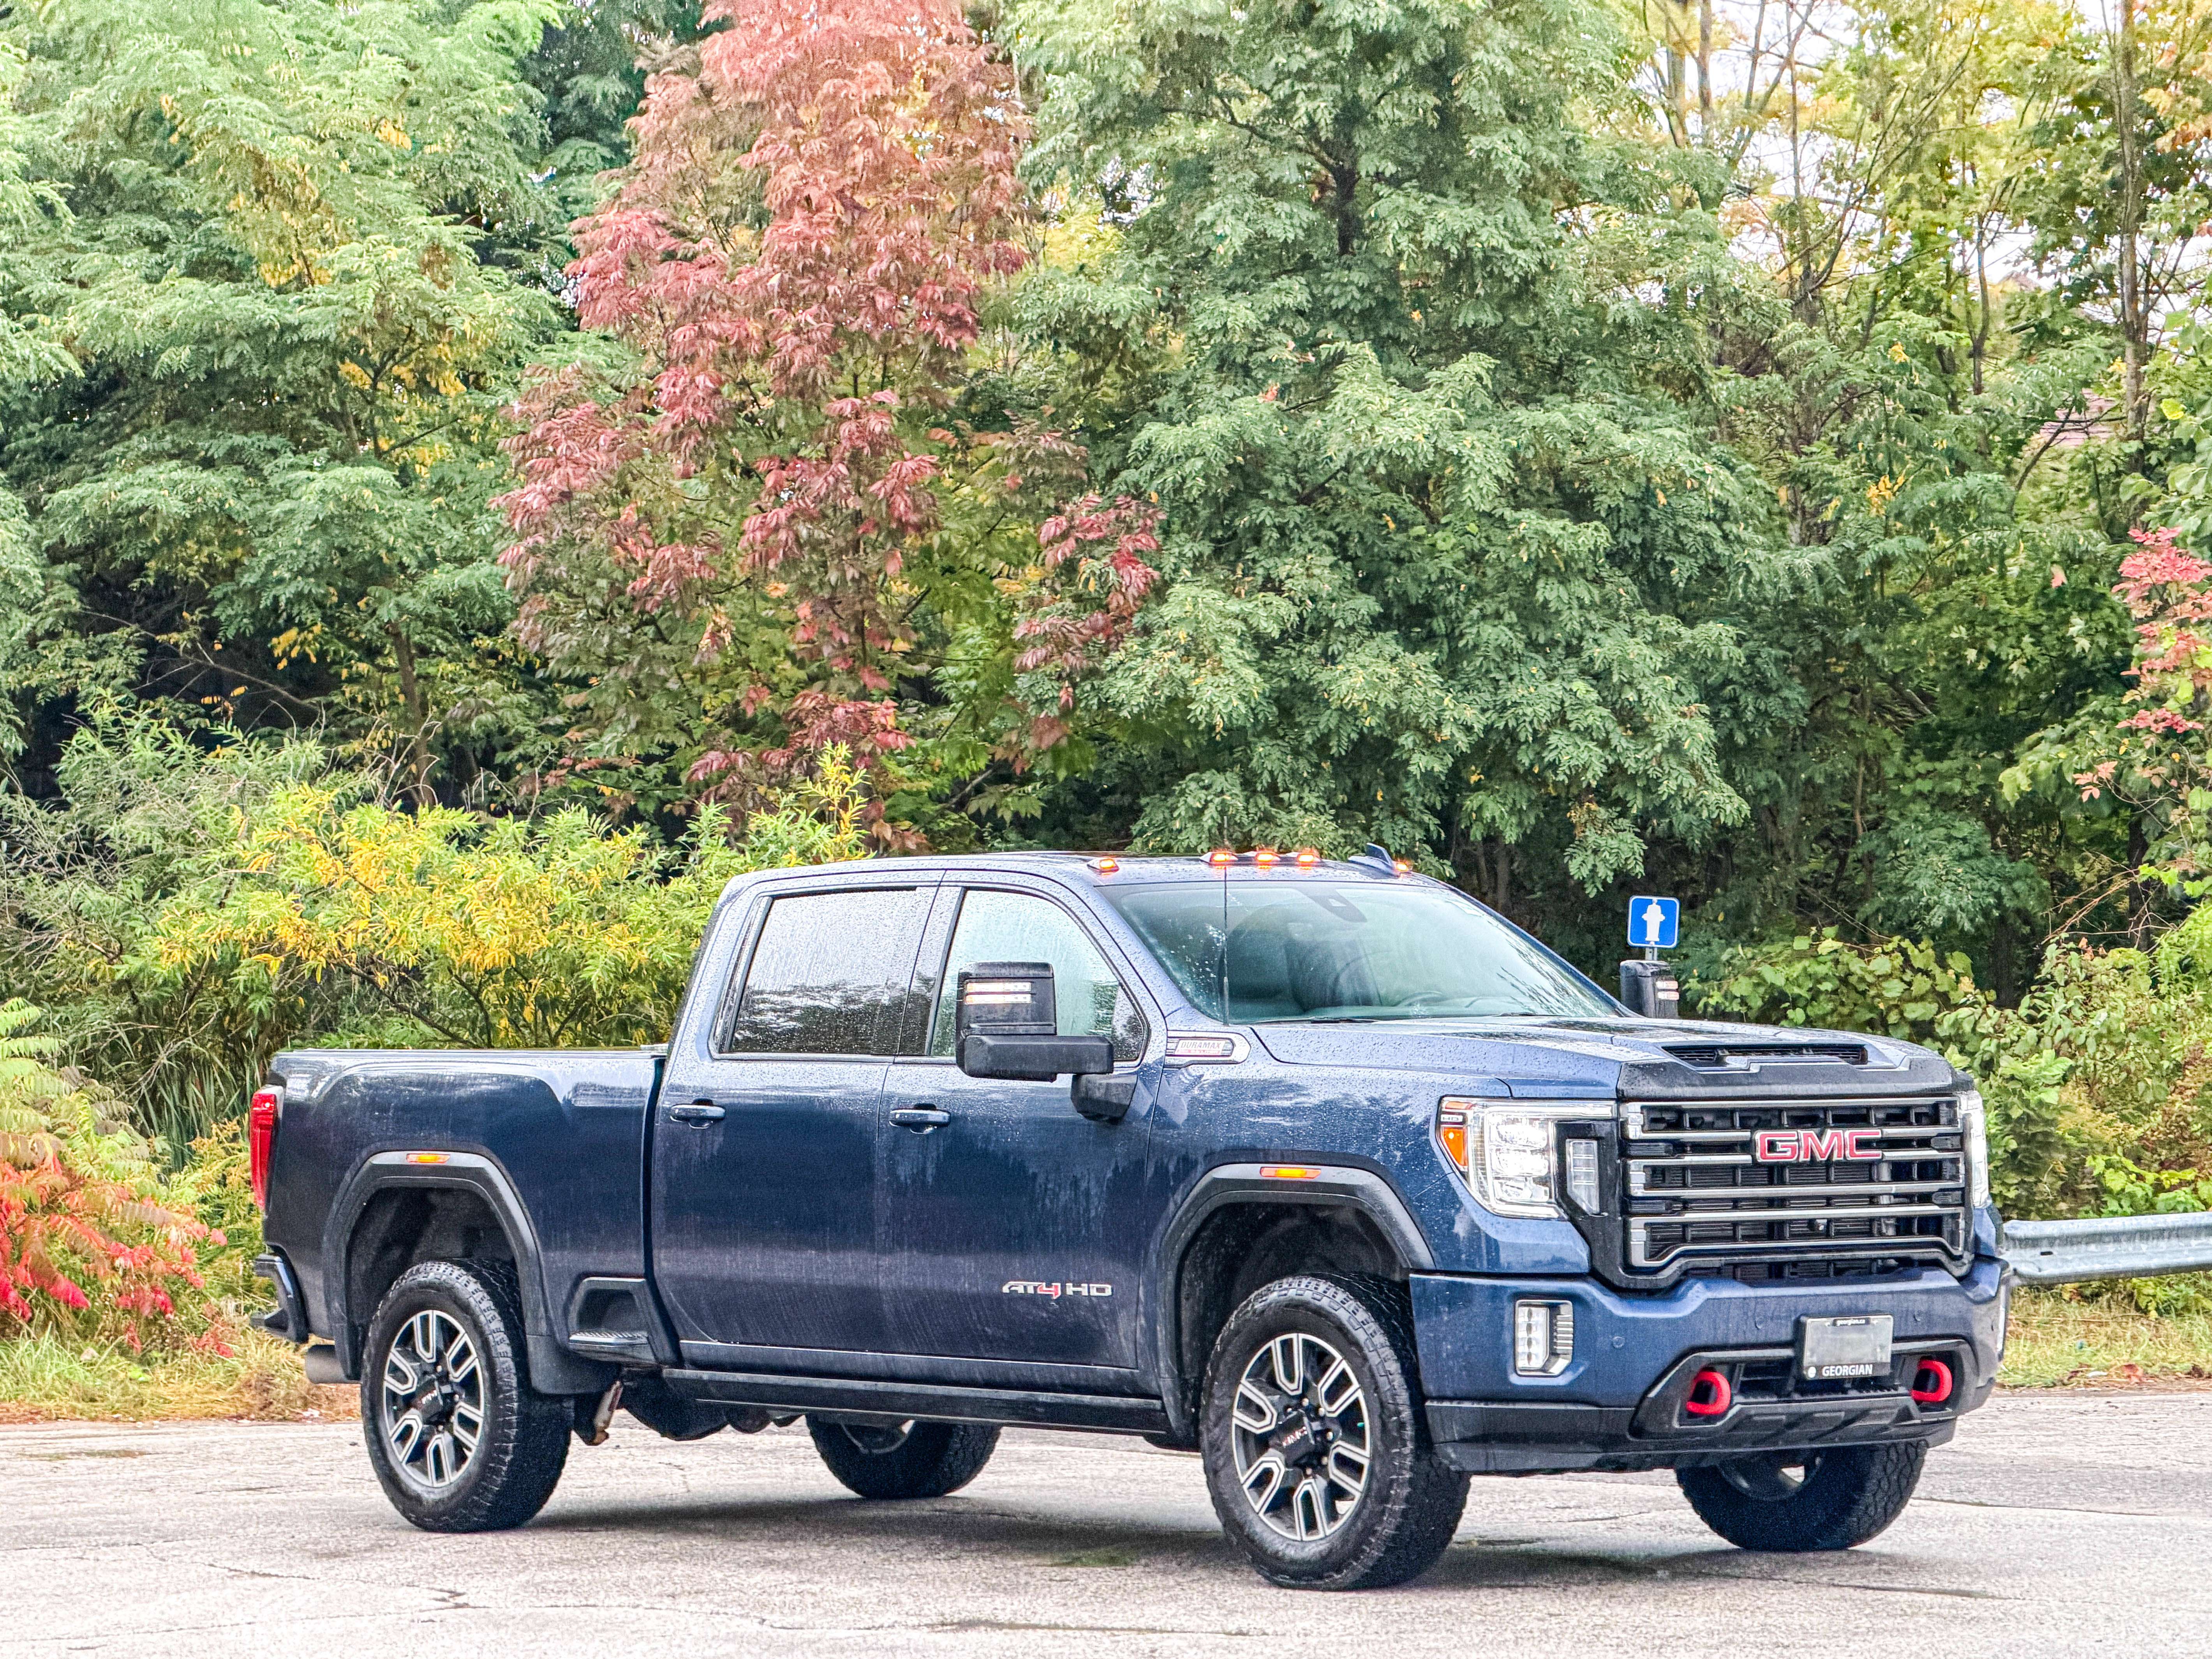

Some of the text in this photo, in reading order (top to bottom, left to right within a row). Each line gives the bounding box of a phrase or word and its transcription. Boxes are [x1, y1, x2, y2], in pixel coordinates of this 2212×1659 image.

[1754, 1128, 1882, 1162] GMC
[1002, 1281, 1112, 1300] AT4 HD
[1836, 1318, 1865, 1326] georgian.ca
[1822, 1364, 1873, 1376] GEORGIAN
